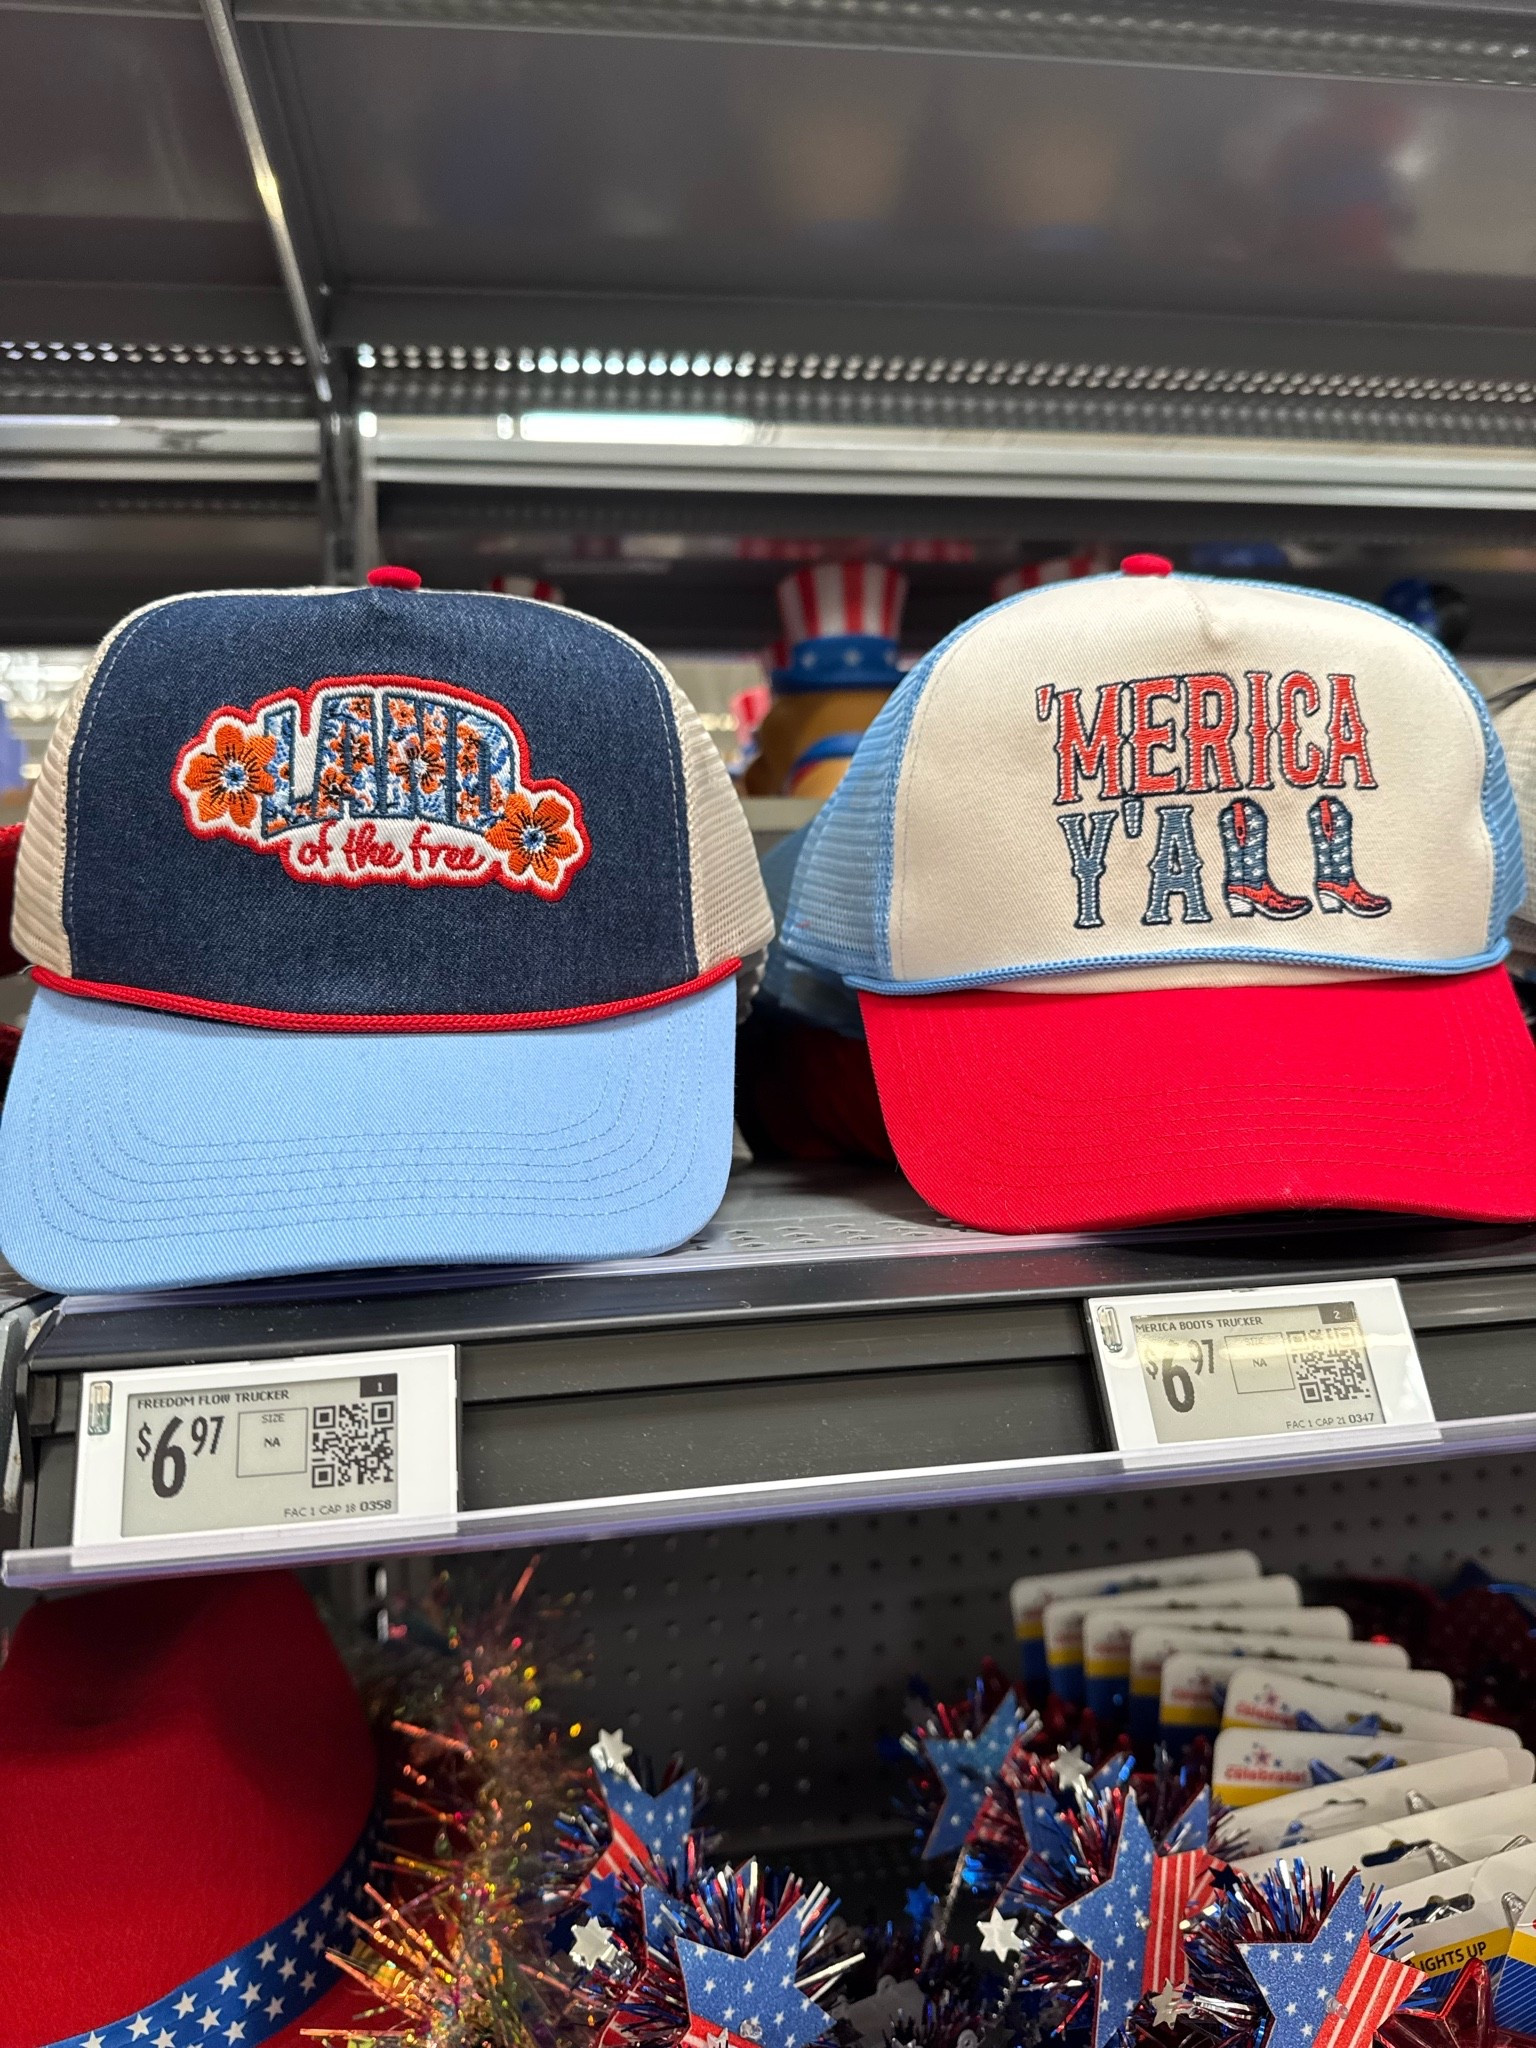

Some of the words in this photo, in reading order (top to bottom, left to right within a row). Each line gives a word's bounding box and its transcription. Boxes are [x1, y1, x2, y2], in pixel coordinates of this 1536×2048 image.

[262, 692, 516, 841] LAND
[302, 820, 338, 869] of
[342, 823, 403, 870] the
[408, 824, 487, 872] free
[1332, 1310, 1342, 1320] 2
[1135, 1321, 1177, 1334] MERICA
[1179, 1319, 1214, 1331] BOOTS
[1216, 1316, 1264, 1328] TRUCKER
[1252, 1358, 1268, 1368] NA
[377, 1382, 383, 1393] 1
[137, 1396, 196, 1410] FREEDOM
[199, 1394, 231, 1405] FLOW
[235, 1389, 290, 1403] TRUCKER
[261, 1412, 286, 1424] SIZE
[1286, 1420, 1306, 1429] FAC
[1315, 1417, 1334, 1427] CAP
[1336, 1416, 1346, 1425] 21
[1348, 1412, 1374, 1424] 0347
[264, 1438, 281, 1449] NA
[284, 1507, 307, 1518] FAC
[319, 1504, 342, 1516] CAP
[359, 1499, 393, 1513] 0358
[1466, 1941, 1488, 1960] UP
